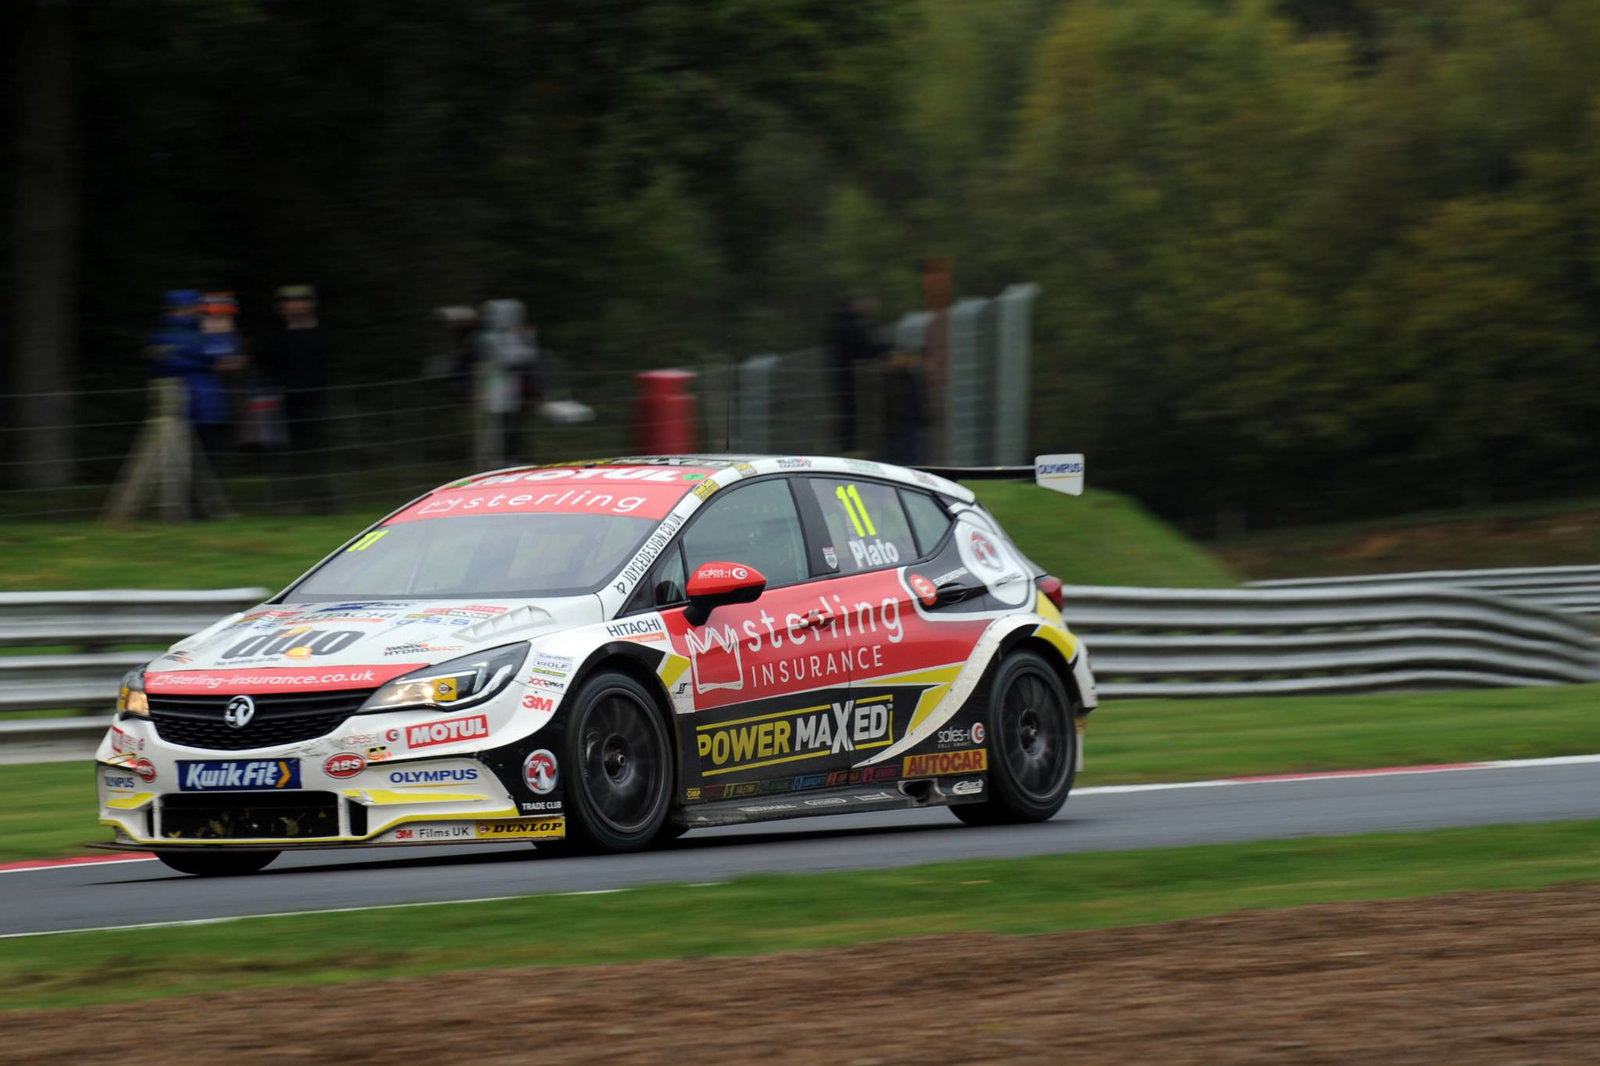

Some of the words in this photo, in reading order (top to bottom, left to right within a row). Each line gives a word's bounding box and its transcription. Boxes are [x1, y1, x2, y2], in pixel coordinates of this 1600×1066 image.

[462, 490, 647, 512] sterling
[835, 484, 876, 537] 11
[347, 530, 390, 552] 11
[848, 538, 900, 568] Plato
[606, 618, 662, 637] HITACHI
[742, 594, 904, 652] sterling
[751, 645, 884, 688] INSURANCE
[522, 695, 553, 712] 3M
[410, 717, 487, 745] MOTUL
[795, 700, 888, 754] MAXED
[697, 720, 791, 766] POWER
[330, 759, 362, 773] ABS
[908, 751, 983, 777] AUTOCAR
[389, 769, 478, 784] OLYMPUS
[687, 790, 700, 798] OMP
[521, 802, 546, 811] TRADE
[546, 801, 562, 810] CLUB
[395, 829, 413, 839] 3M
[419, 828, 450, 838] Films
[453, 827, 470, 837] UK
[493, 822, 562, 833] DUNLOP
